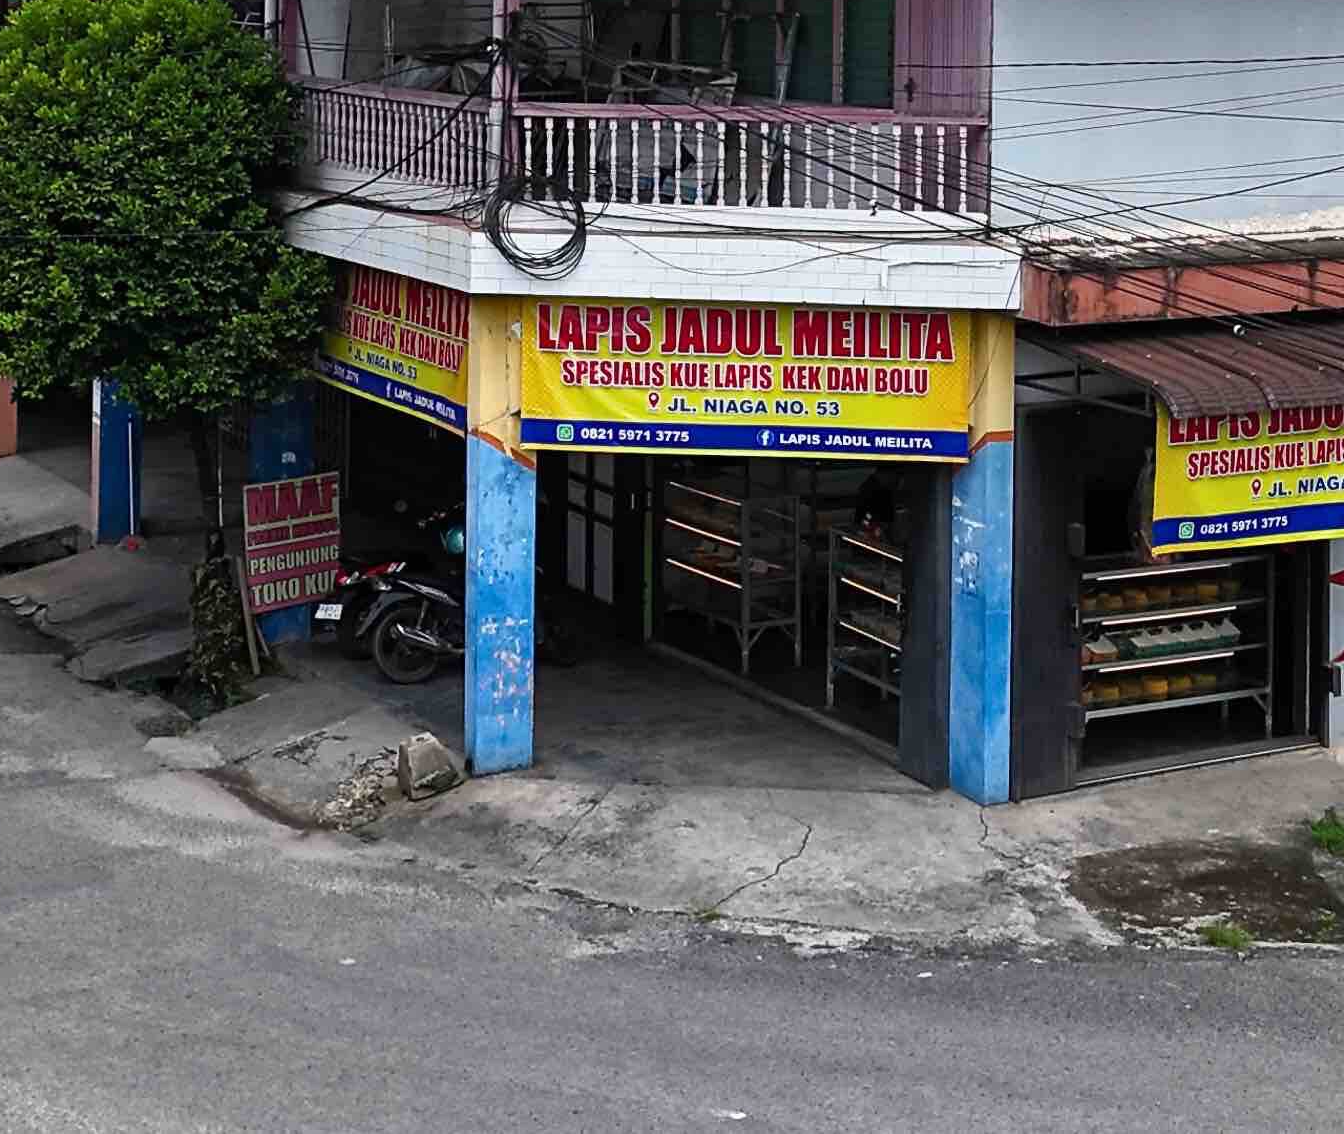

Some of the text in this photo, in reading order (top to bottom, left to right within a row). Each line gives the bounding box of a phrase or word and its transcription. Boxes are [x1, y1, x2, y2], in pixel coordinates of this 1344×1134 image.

[538, 303, 955, 361] LAPIS JADUL MEILITA
[562, 360, 928, 394] SPESIALIS KUE LAPIS KEK DAN BOLU
[668, 398, 840, 416] JL. NIAGA NO. 53
[580, 427, 690, 442] 0821 5971 3775
[779, 433, 820, 445] LAPIS
[825, 434, 871, 447] JADUL
[875, 436, 933, 449] MEILITA
[1188, 445, 1270, 477] SPESIALIS
[1274, 443, 1304, 468] KUE
[1268, 483, 1292, 497] JL.
[1200, 516, 1288, 534] 0821 5971 3775
[249, 545, 339, 576] PENGUNJUNG
[250, 577, 299, 606] TOKO
